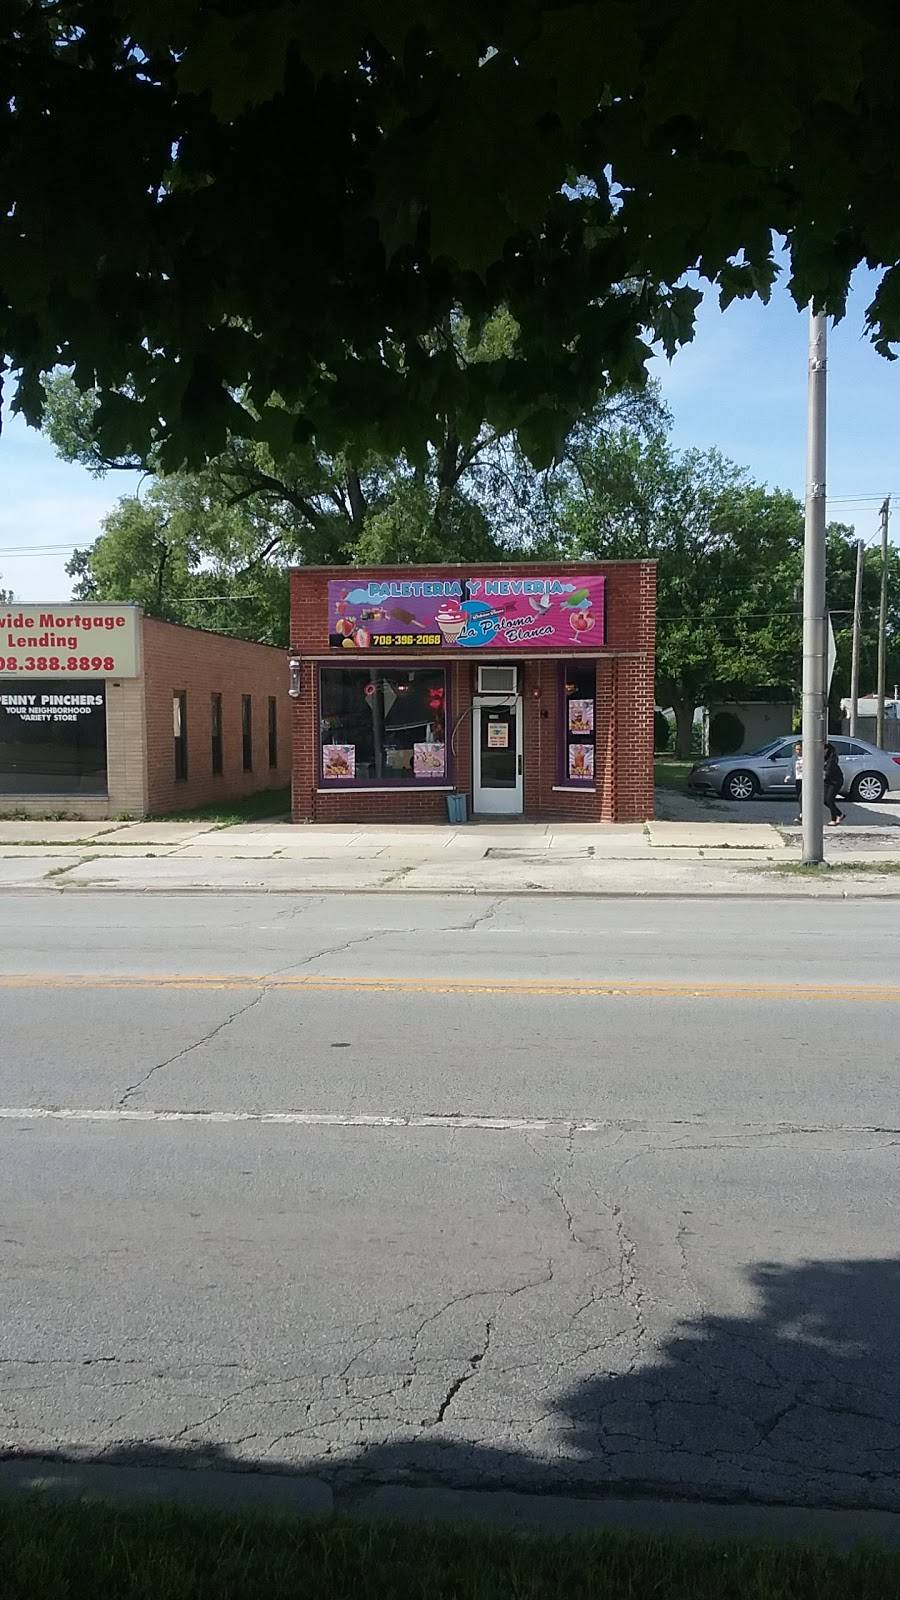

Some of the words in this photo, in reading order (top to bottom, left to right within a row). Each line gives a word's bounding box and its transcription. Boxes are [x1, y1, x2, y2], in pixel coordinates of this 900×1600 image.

[368, 582, 463, 597] PALETERIA
[466, 581, 481, 596] Y
[485, 580, 564, 595] NEVERIA
[39, 614, 126, 630] Mortgage
[457, 625, 477, 640] La
[480, 615, 534, 635] Paloma
[8, 633, 77, 649] Lending
[504, 625, 554, 643] Blanca
[0, 695, 36, 705] ENNY
[41, 695, 103, 705] PINCHERS
